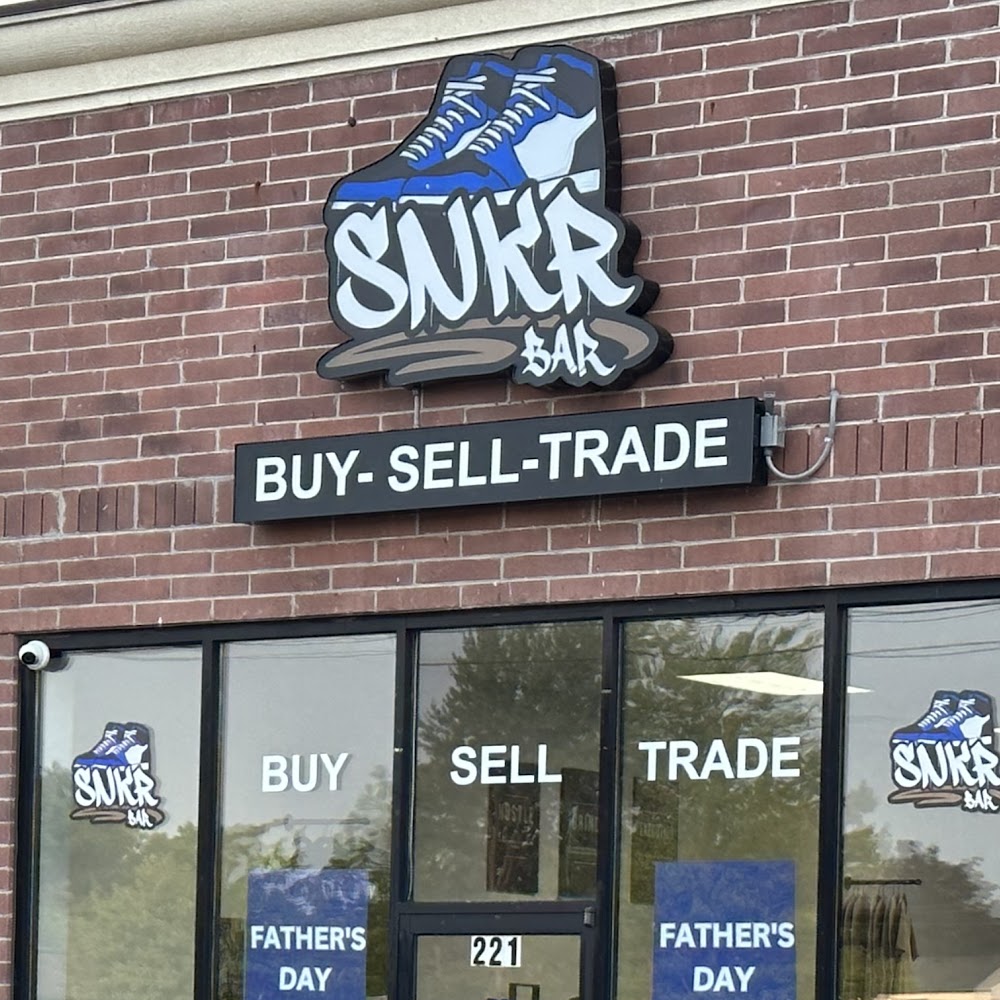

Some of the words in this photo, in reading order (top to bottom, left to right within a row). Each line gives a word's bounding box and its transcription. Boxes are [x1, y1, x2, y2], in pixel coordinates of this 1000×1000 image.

[333, 186, 636, 330] SNKR
[520, 319, 617, 378] BAR
[261, 752, 349, 793] BUY
[450, 744, 562, 785] SELL
[638, 737, 800, 781] TRADE
[893, 740, 1000, 789] SNKR
[73, 765, 159, 807] SNKR
[964, 788, 999, 811] BAR
[250, 925, 367, 951] FATHER'S
[472, 936, 518, 966] 221
[660, 921, 795, 949] FATHER'S
[278, 967, 332, 992] DAY
[693, 966, 755, 992] DAY
